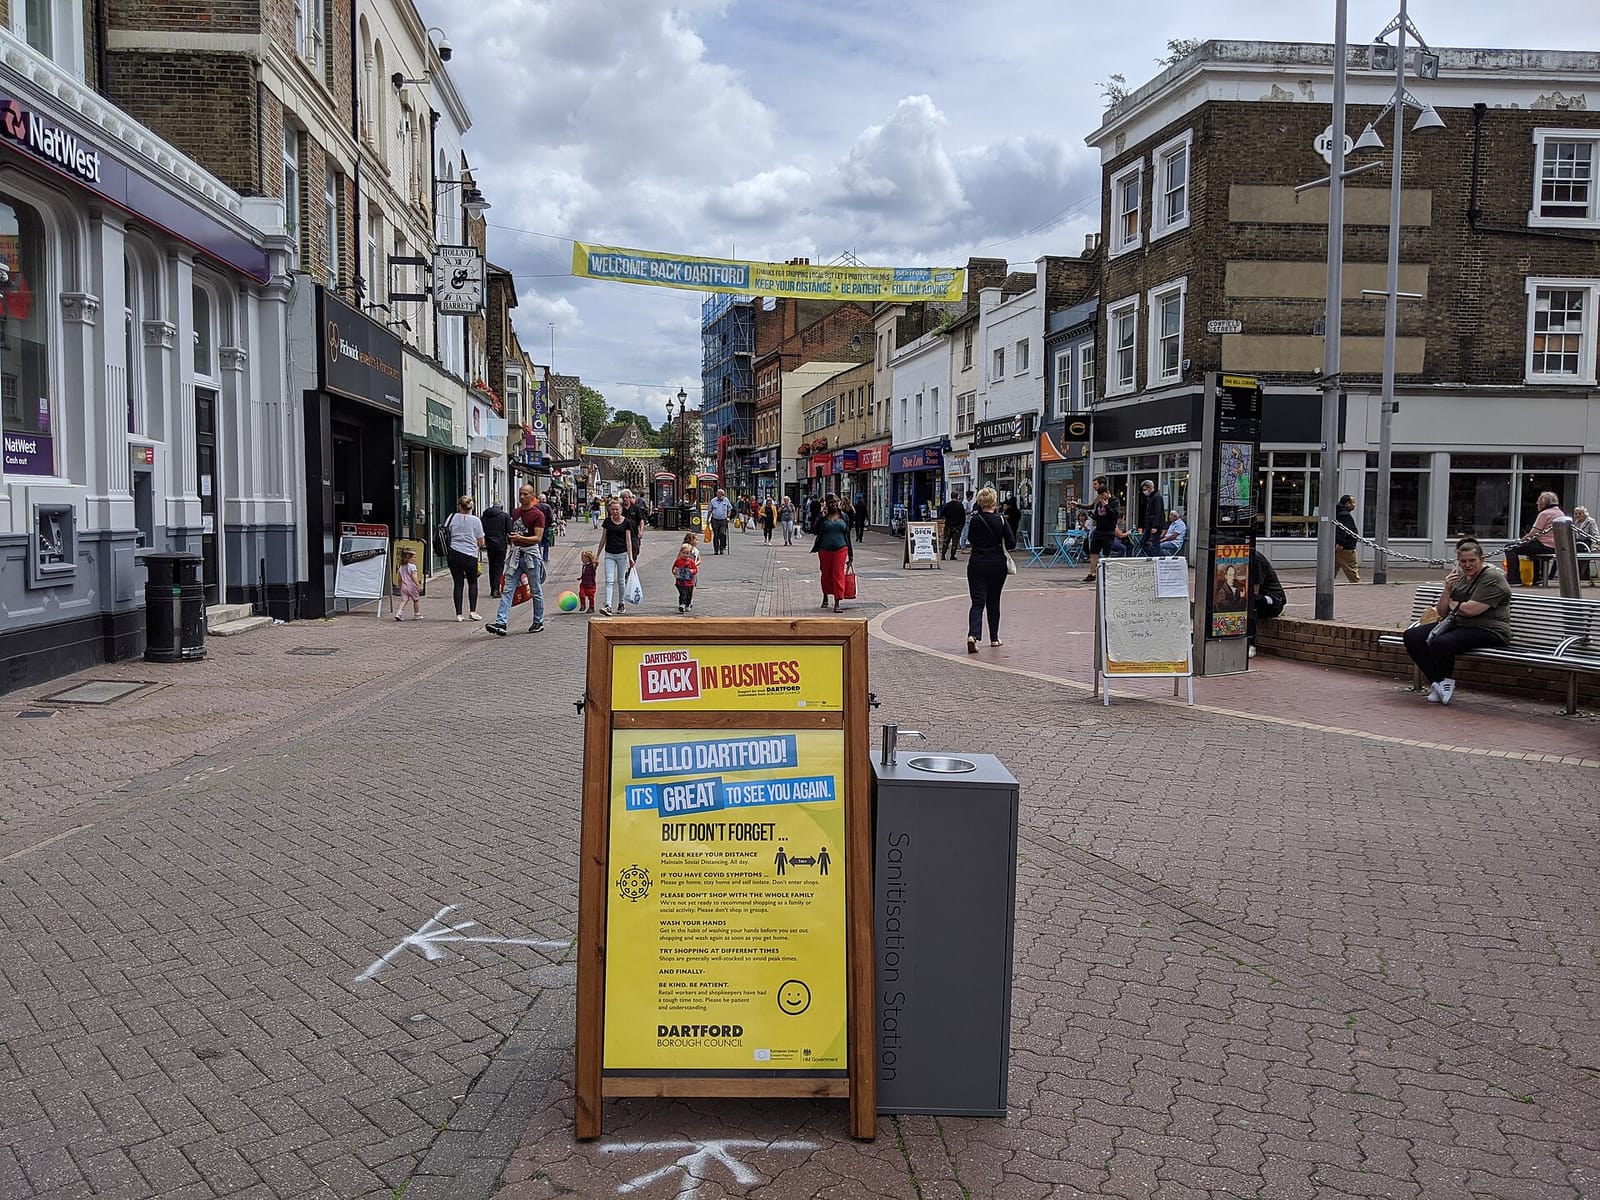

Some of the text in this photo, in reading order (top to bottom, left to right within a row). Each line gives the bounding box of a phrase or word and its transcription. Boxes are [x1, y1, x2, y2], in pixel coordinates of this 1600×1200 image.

[29, 112, 101, 184] NatWest
[1320, 139, 1347, 151] 181
[442, 249, 474, 258] HOLLAND
[591, 255, 745, 285] WELCOME BACK DARTFORD
[755, 279, 949, 295] KEEP YOUR DISTANCE BE PATIENT FOLLOW ADVICE
[443, 302, 474, 311] BARRETT
[983, 420, 1016, 438] VALENTINO
[1135, 423, 1187, 439] ESQUIRES COFFEE
[4, 437, 37, 454] NatWest
[6, 456, 18, 464] Cash
[902, 456, 912, 468] Shoe
[926, 457, 938, 465] Zone
[1216, 545, 1249, 558] LOVE
[645, 651, 688, 665] DARTFORD'S
[647, 660, 800, 695] BACK IN BUSINESS
[640, 739, 788, 774] HELLO DARTFORD!
[631, 780, 832, 812] IT'S GREAT TO SEE YOU AGAIN.
[661, 823, 776, 842] BUT DON'T FORGET
[881, 831, 910, 1081] Sanitisation Station
[658, 1025, 744, 1037] DARTFORD
[657, 1039, 743, 1047] BOROUGH COUNCIL
